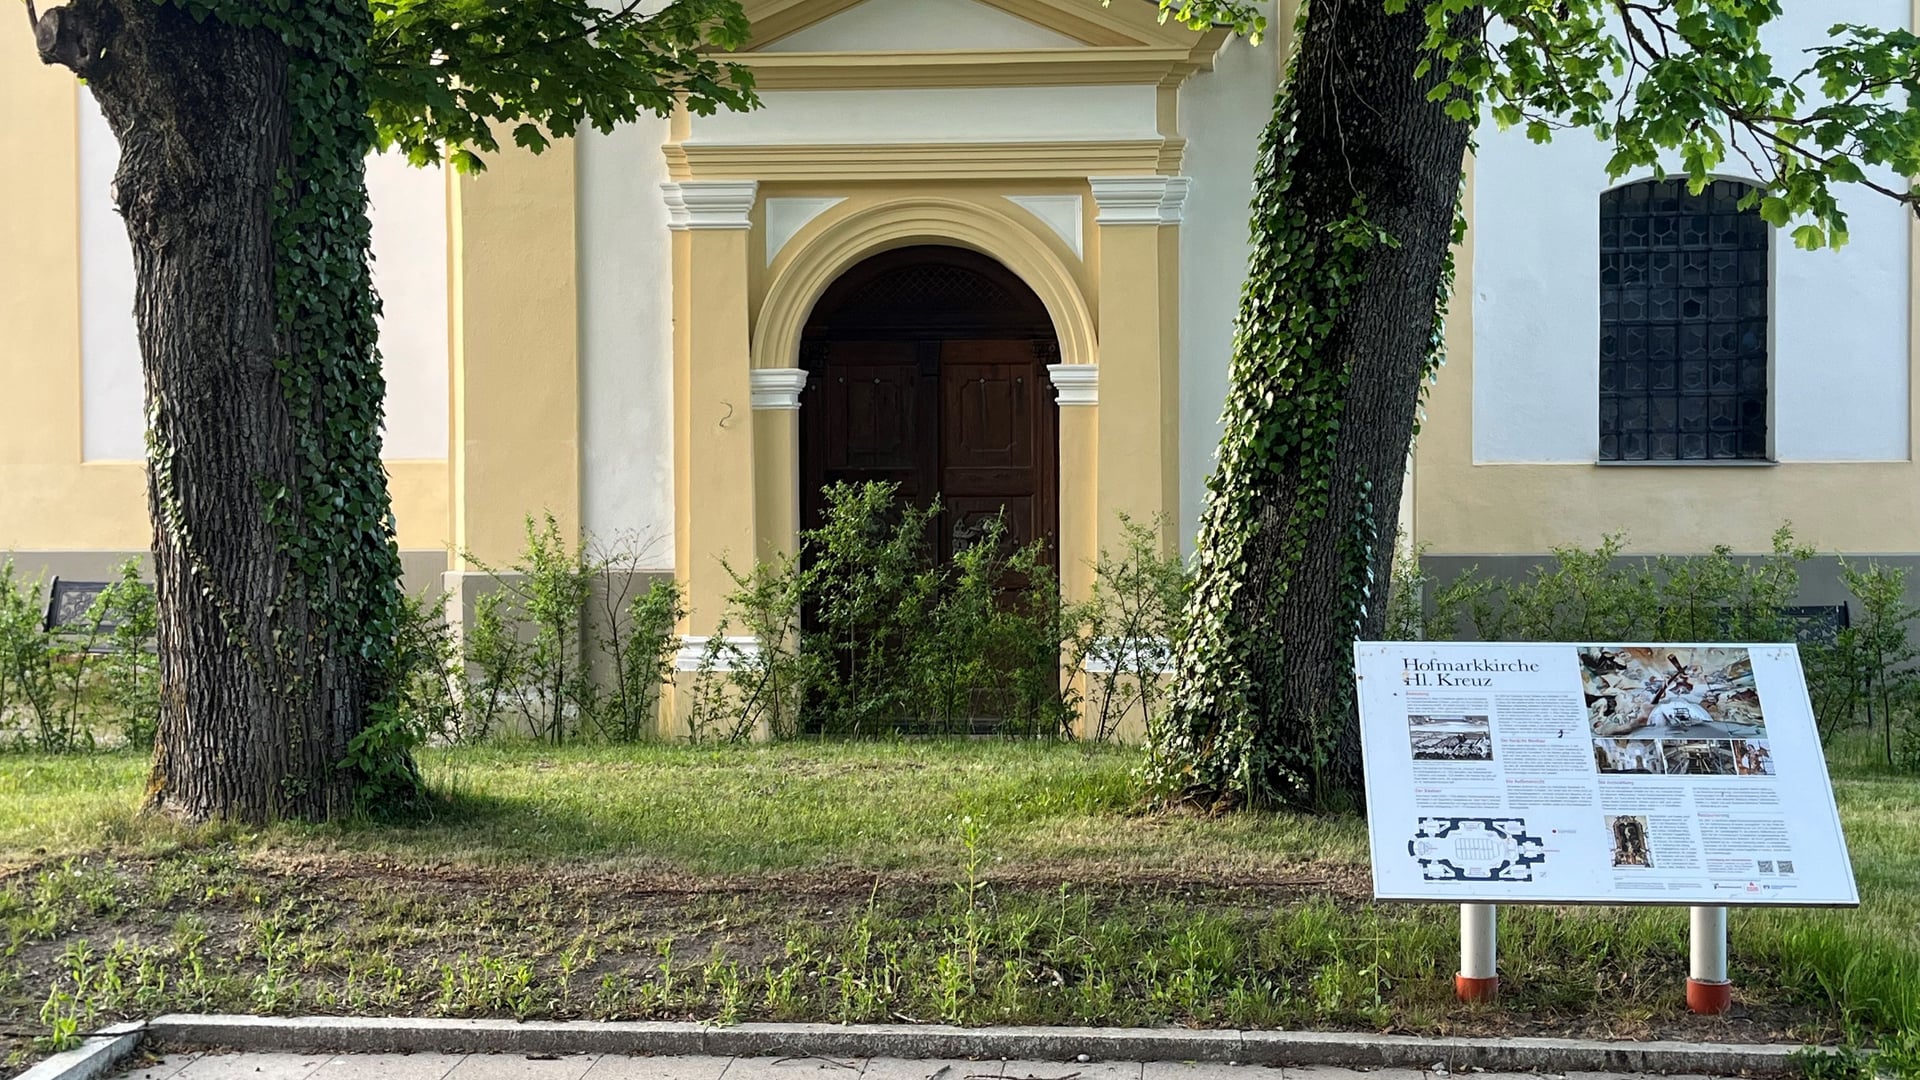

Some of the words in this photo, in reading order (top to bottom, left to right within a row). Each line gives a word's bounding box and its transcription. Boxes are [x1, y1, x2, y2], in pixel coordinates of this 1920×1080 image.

[1402, 658, 1540, 673] Hofmarkkirche
[1404, 673, 1432, 687] Hl.
[1437, 673, 1493, 687] Kreuz
